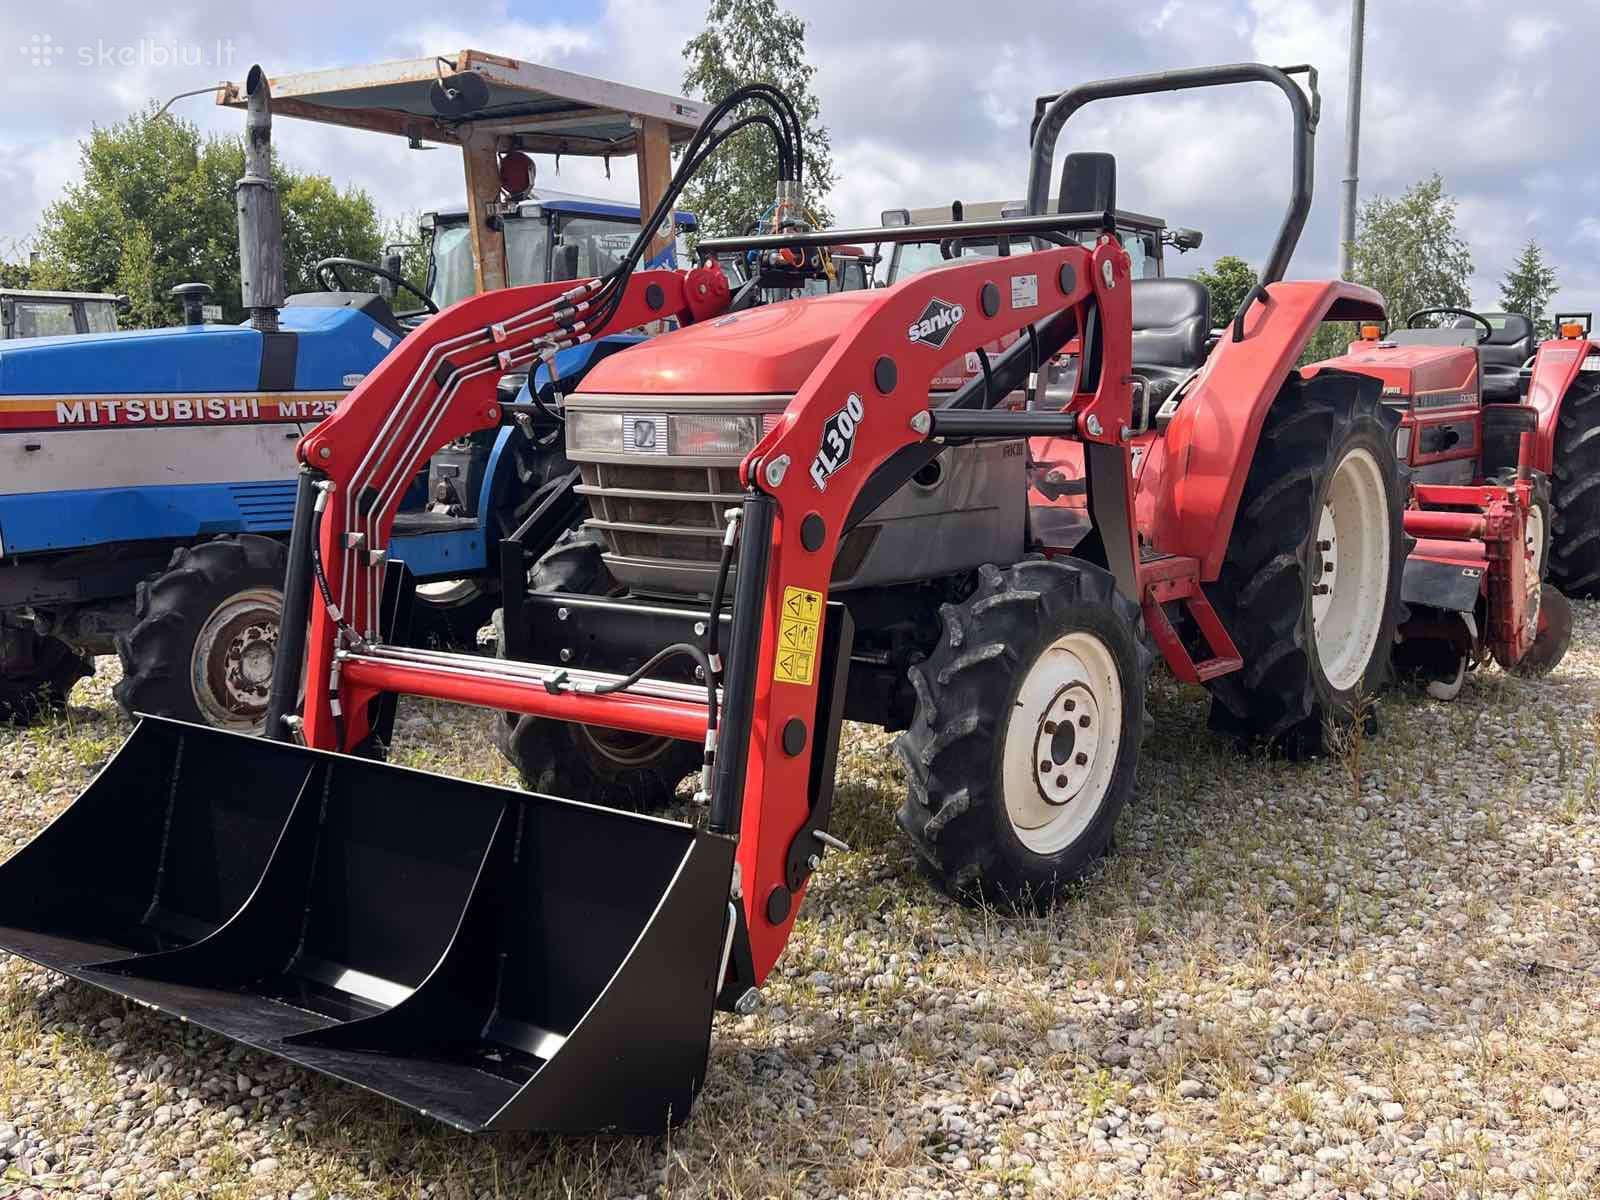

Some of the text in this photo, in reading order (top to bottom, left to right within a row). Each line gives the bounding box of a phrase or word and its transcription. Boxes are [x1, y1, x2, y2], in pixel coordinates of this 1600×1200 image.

[908, 304, 964, 342] sanko
[56, 398, 338, 423] MITSUBISHI MT25
[809, 393, 864, 491] FL300
